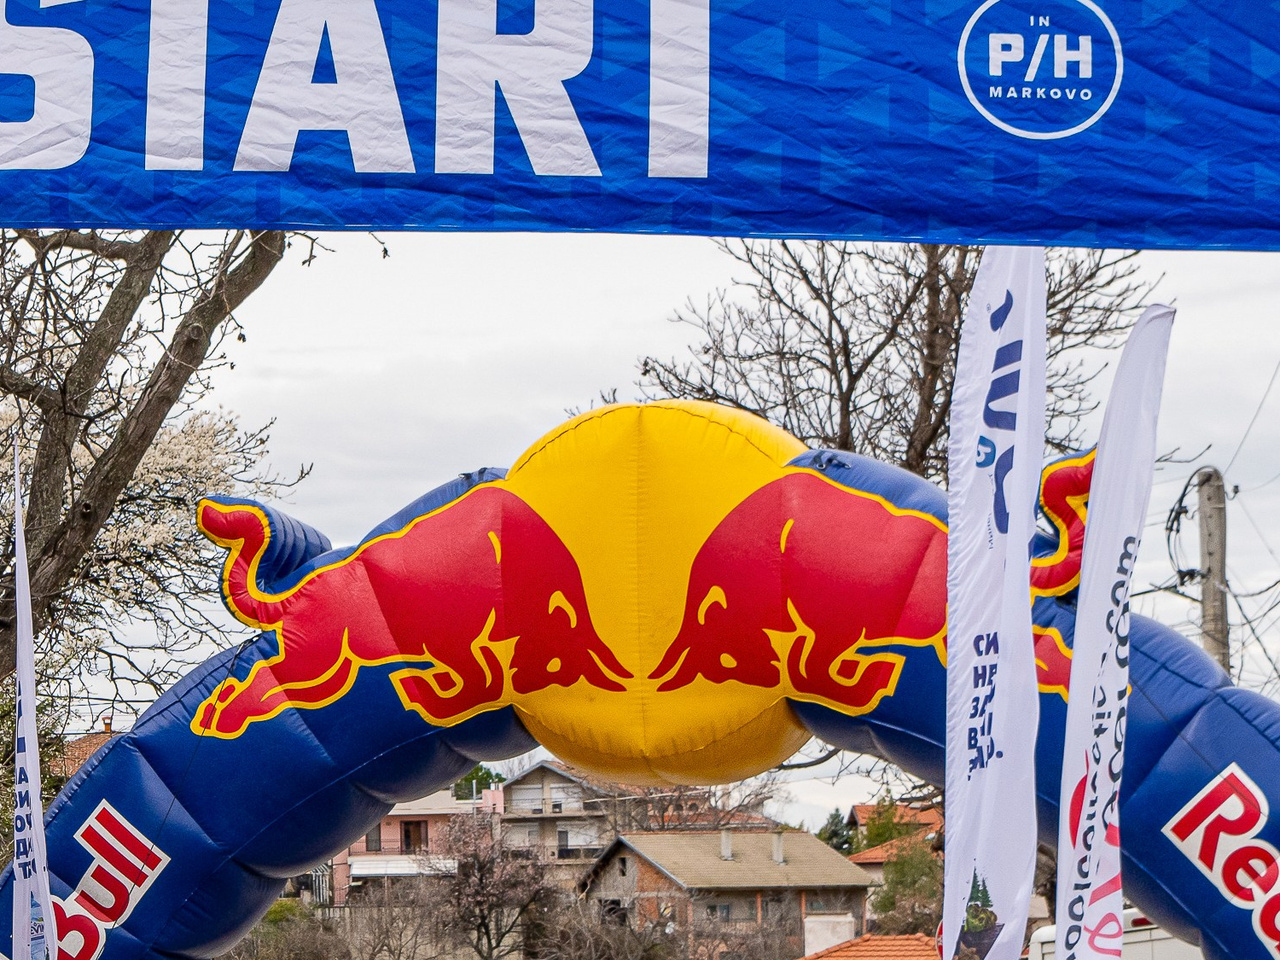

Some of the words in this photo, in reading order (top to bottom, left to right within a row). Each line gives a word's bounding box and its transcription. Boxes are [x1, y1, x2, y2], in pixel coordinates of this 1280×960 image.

[1029, 15, 1050, 27] IN
[989, 33, 1092, 82] P/H
[989, 86, 1093, 101] MARKOVO
